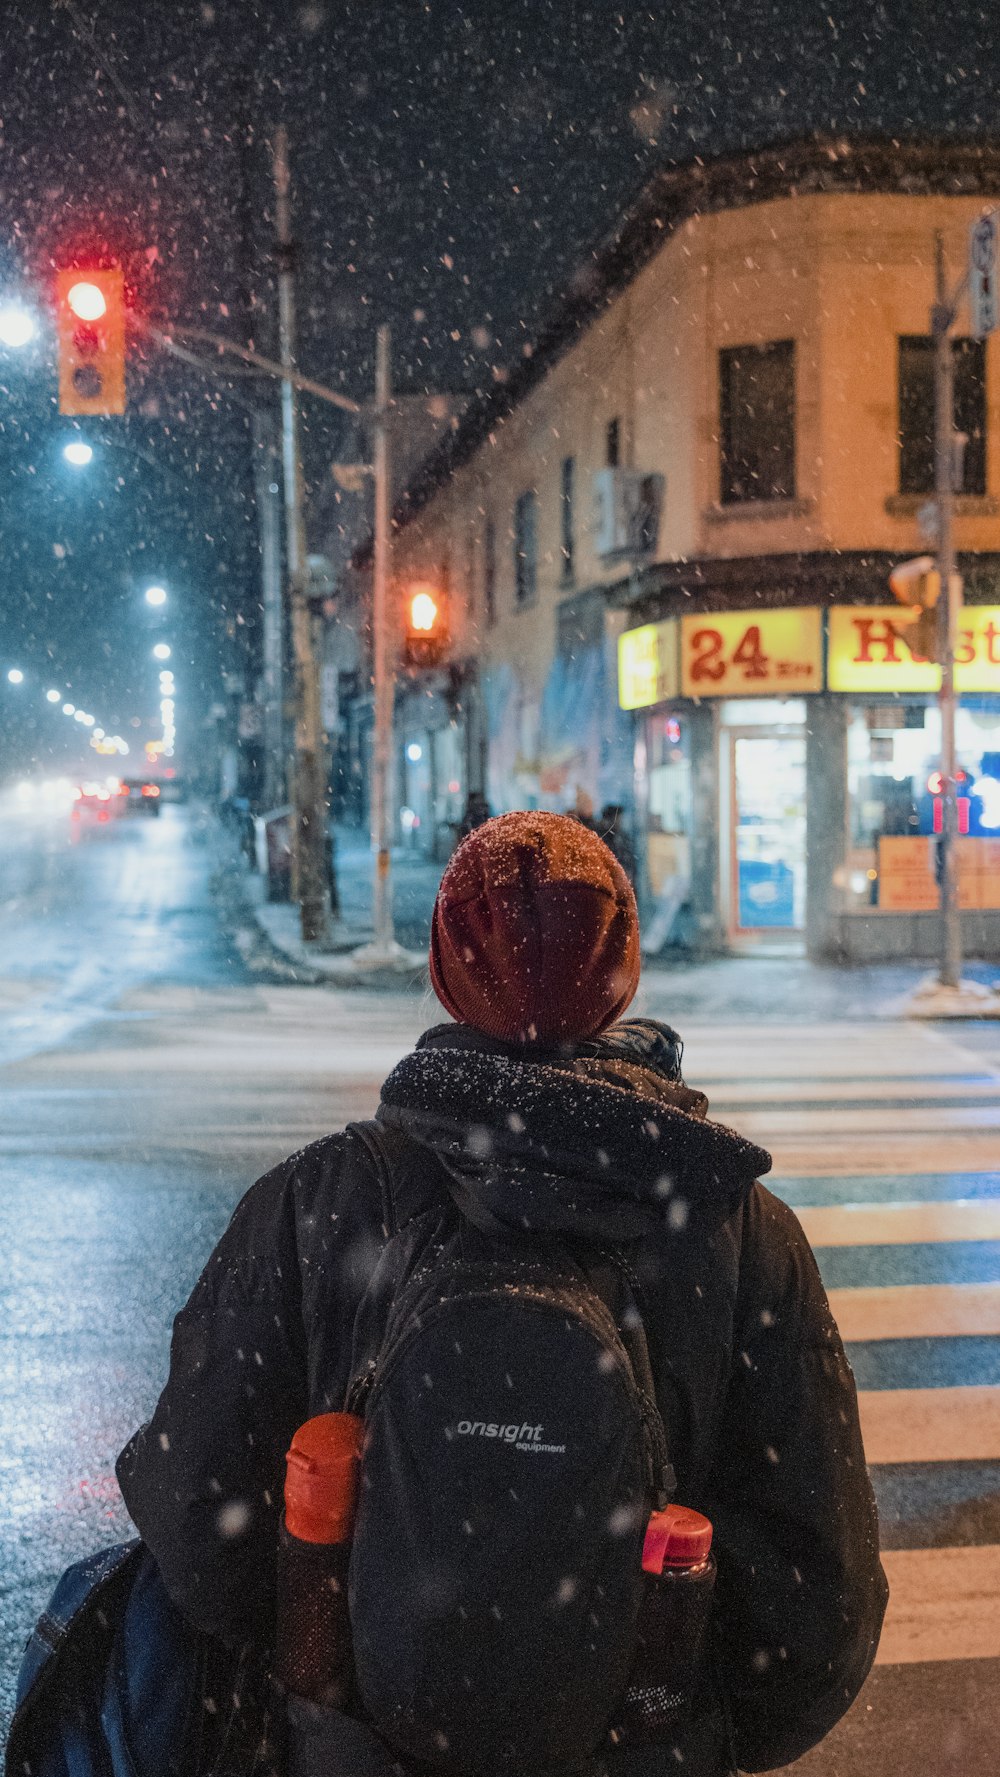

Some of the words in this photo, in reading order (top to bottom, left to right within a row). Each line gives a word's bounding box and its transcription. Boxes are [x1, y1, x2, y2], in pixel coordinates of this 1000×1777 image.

[690, 625, 768, 681] 24
[457, 1420, 544, 1442] onsight
[515, 1441, 566, 1453] equipment
